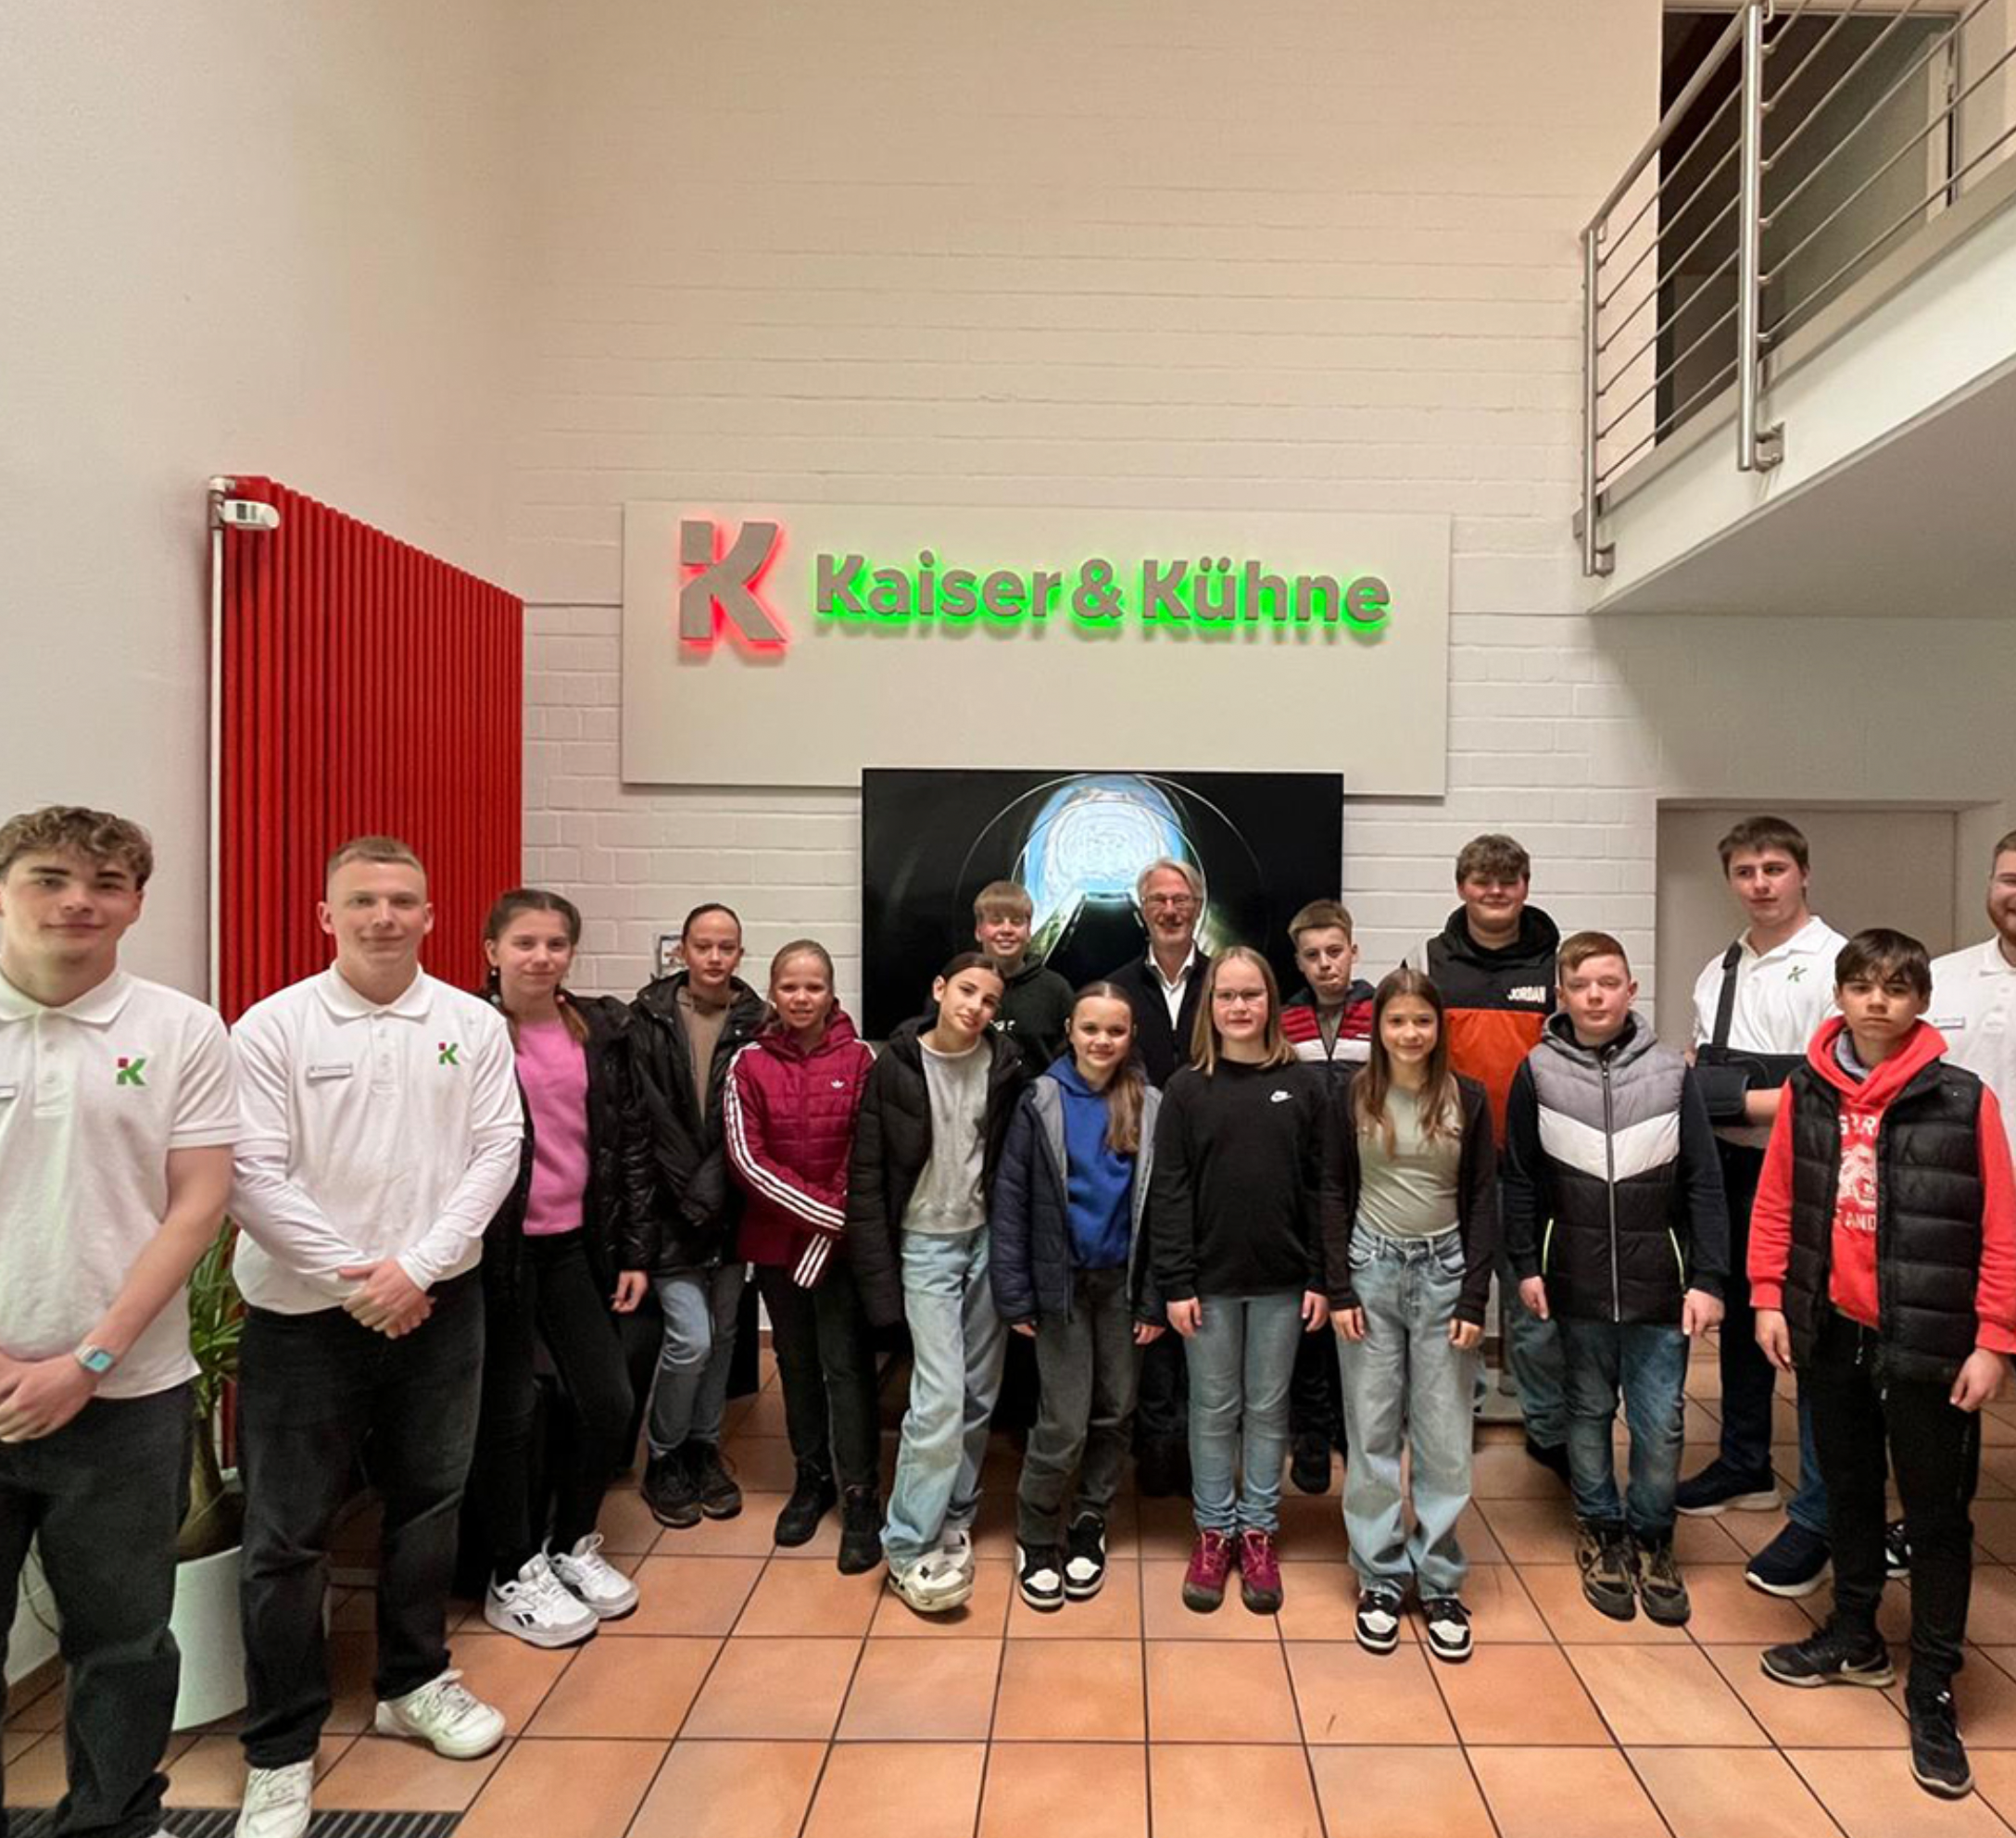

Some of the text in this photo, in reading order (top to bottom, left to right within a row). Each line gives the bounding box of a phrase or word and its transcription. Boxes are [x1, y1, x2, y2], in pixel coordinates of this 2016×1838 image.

[816, 550, 1062, 618] Kaiser
[1071, 559, 1123, 619] &
[1141, 557, 1391, 623] Kühne
[1506, 986, 1546, 1003] JORDAN
